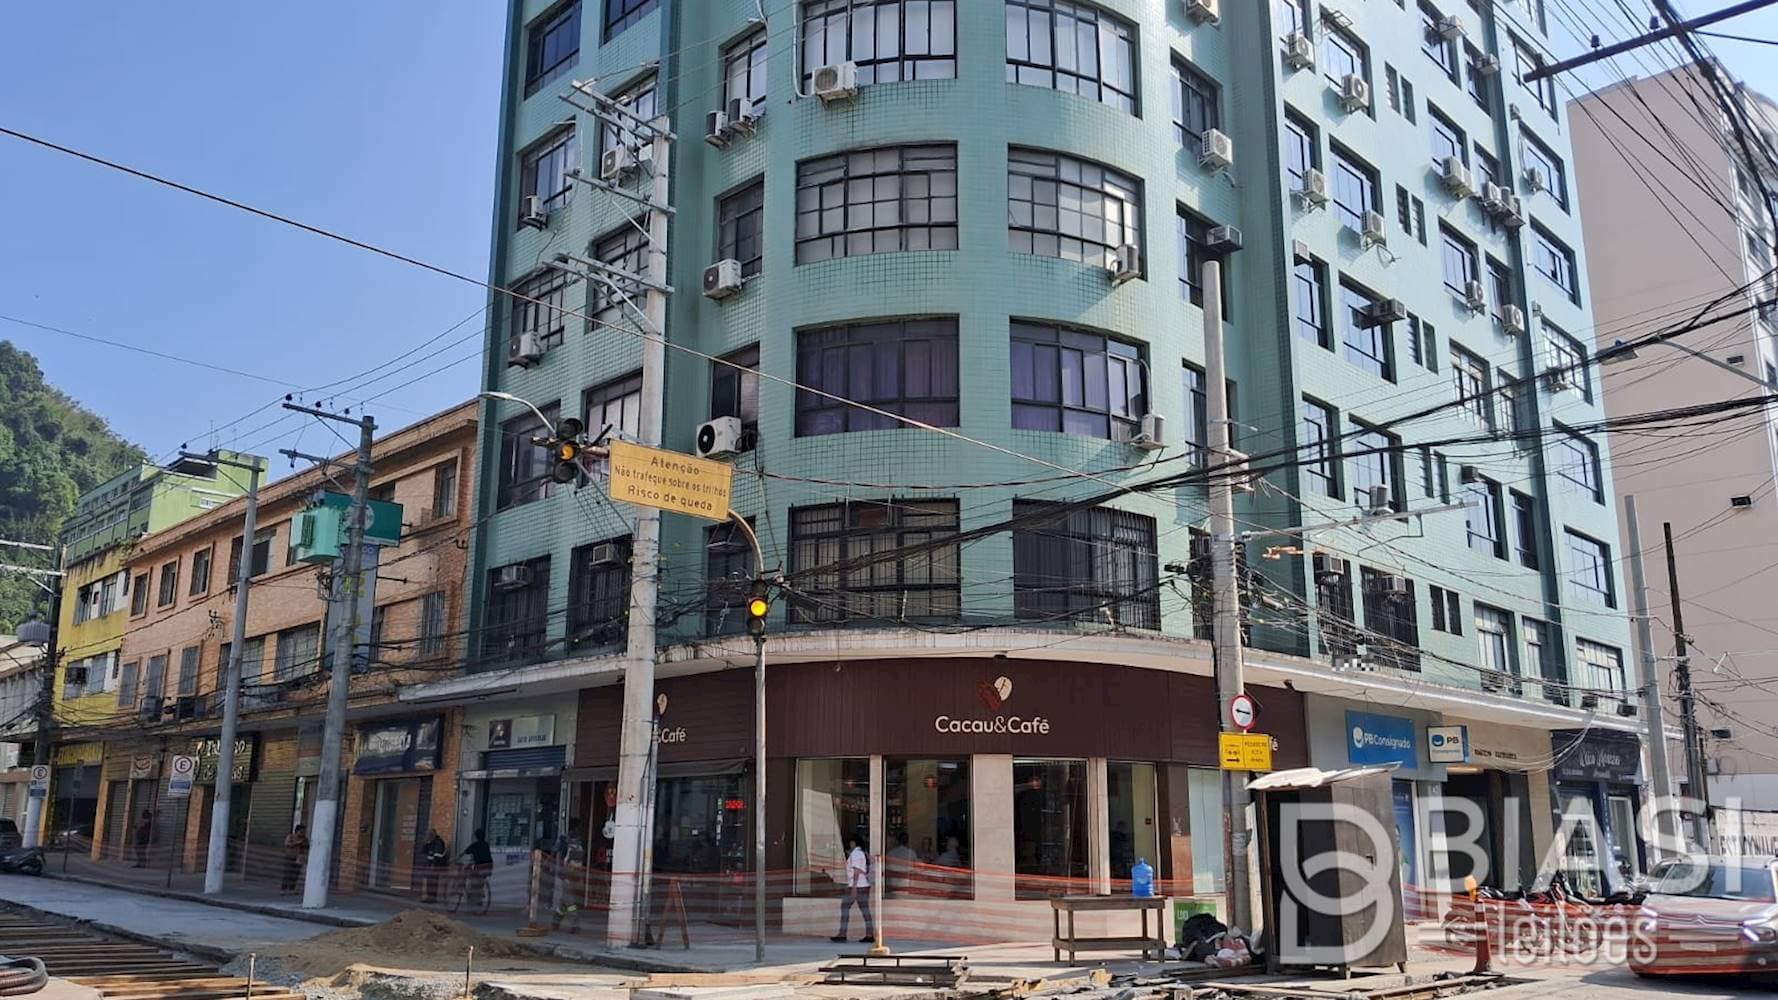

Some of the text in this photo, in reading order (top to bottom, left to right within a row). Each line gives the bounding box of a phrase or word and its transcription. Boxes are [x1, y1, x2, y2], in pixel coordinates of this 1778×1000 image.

[651, 456, 700, 475] Atenção
[614, 465, 630, 477] Não
[668, 476, 690, 489] sobre
[692, 481, 701, 492] os
[702, 482, 727, 497] trilhos
[628, 484, 713, 511] Risco de queda
[935, 715, 1050, 734] Cacau&Café
[1446, 736, 1460, 744] PB
